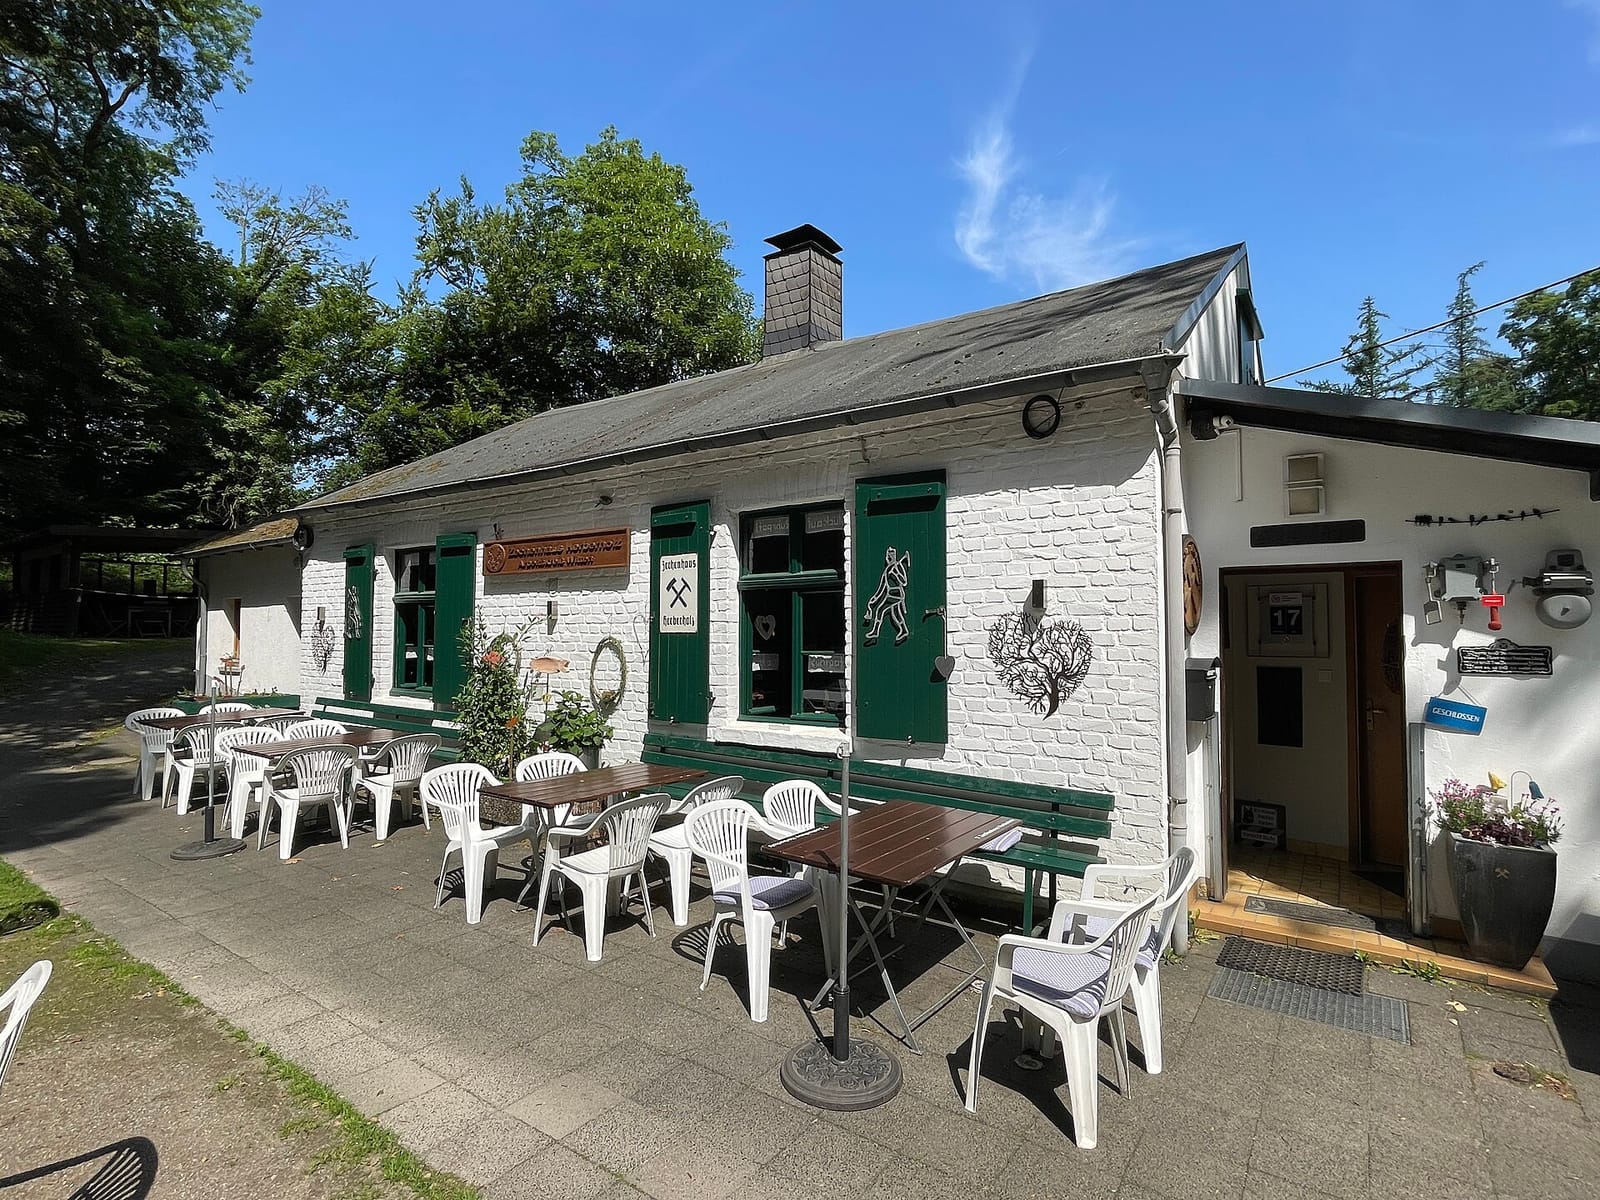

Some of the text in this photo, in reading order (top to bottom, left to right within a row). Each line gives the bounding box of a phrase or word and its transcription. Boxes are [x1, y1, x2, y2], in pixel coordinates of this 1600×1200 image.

[661, 559, 697, 572] Zechenhaus
[662, 615, 696, 628] Herberholz
[1273, 609, 1301, 626] 17
[1432, 707, 1481, 723] GESCHLOSSEN
